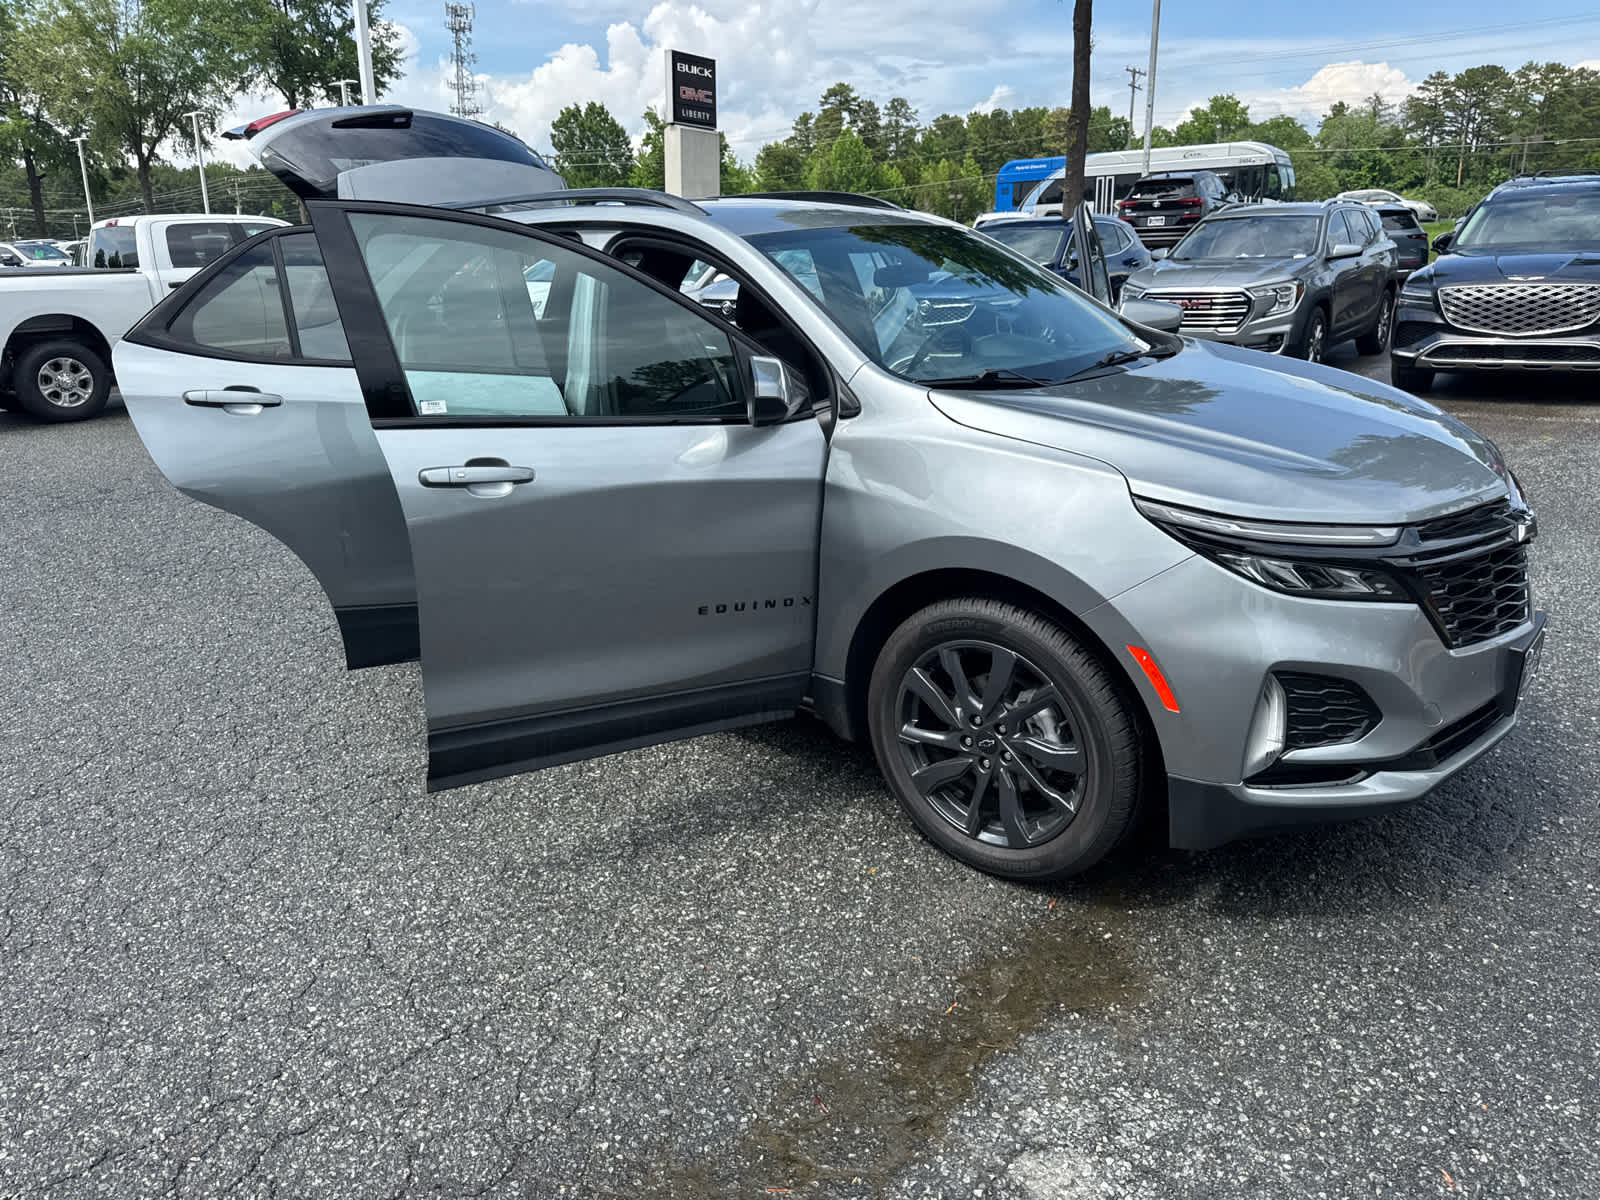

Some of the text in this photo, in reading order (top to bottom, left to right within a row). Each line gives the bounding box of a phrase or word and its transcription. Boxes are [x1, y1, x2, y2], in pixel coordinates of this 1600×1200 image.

[677, 62, 712, 78] BUICK
[680, 86, 713, 103] GMC
[682, 108, 710, 120] LIBERTY
[698, 596, 812, 615] EQUINOX
